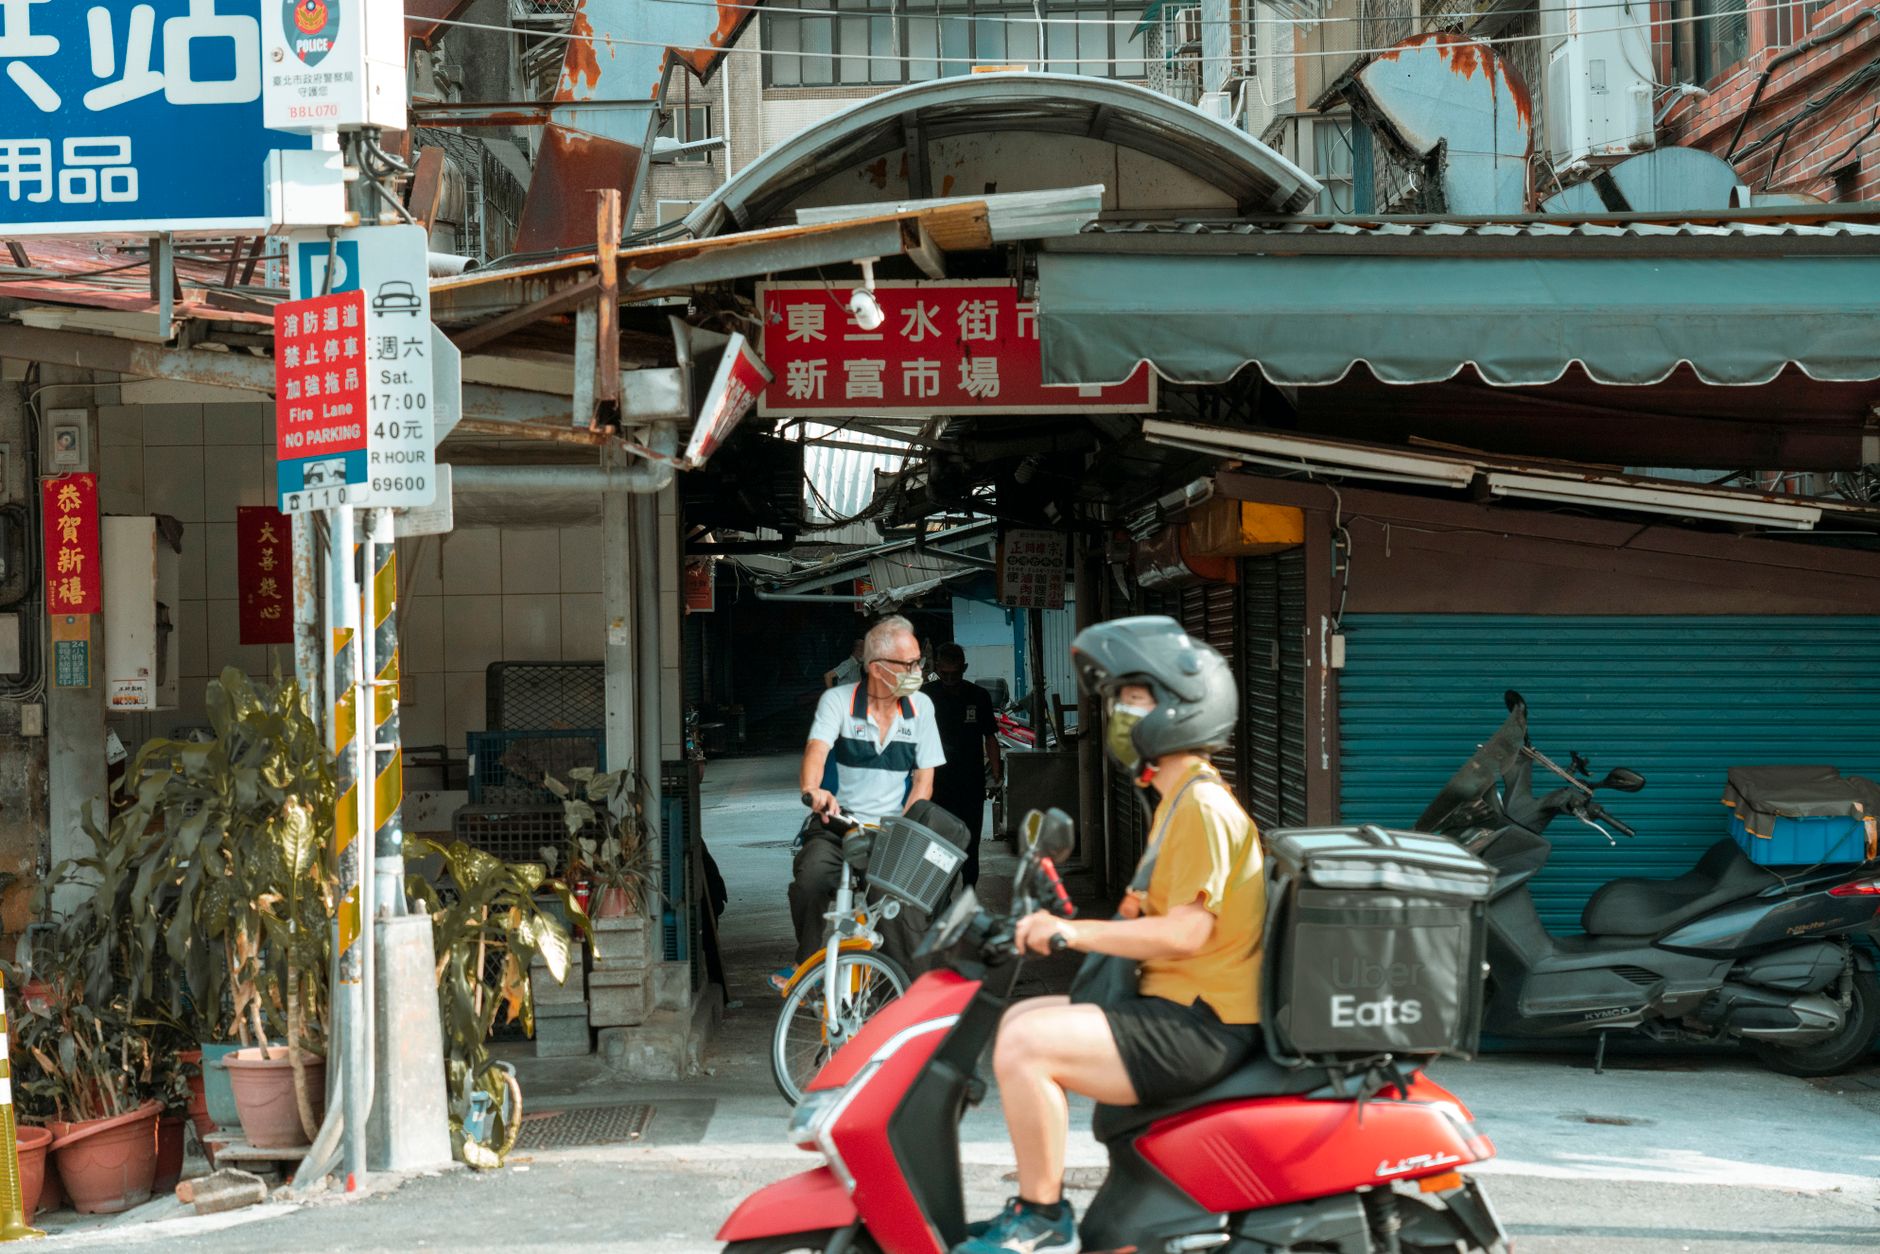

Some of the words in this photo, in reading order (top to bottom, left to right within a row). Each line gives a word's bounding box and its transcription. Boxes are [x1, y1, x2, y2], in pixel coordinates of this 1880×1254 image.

[296, 38, 328, 53] POLICE
[273, 71, 354, 86] 臺北市政府警察局
[298, 86, 328, 98] 守護您
[289, 104, 338, 119] BBL070
[284, 303, 358, 337] 消防通道
[284, 335, 359, 369] 禁止停車
[377, 336, 423, 360] 週六
[286, 367, 359, 399] 加強拖吊
[381, 369, 413, 385] Sat.
[786, 357, 1000, 400] 新富市場
[369, 393, 426, 411] 17:00
[289, 407, 314, 423] Fire
[322, 403, 353, 418] Lane
[285, 431, 304, 449] NO
[306, 423, 361, 446] PARKING
[374, 420, 423, 440] 40元
[385, 450, 426, 465] HOUR
[372, 476, 426, 492] 69600
[308, 488, 346, 508] 110
[57, 483, 86, 606] 恭賀新禧
[1331, 956, 1425, 989] Uber
[1331, 994, 1423, 1028] Eats
[1584, 1007, 1631, 1021] KYMCO
